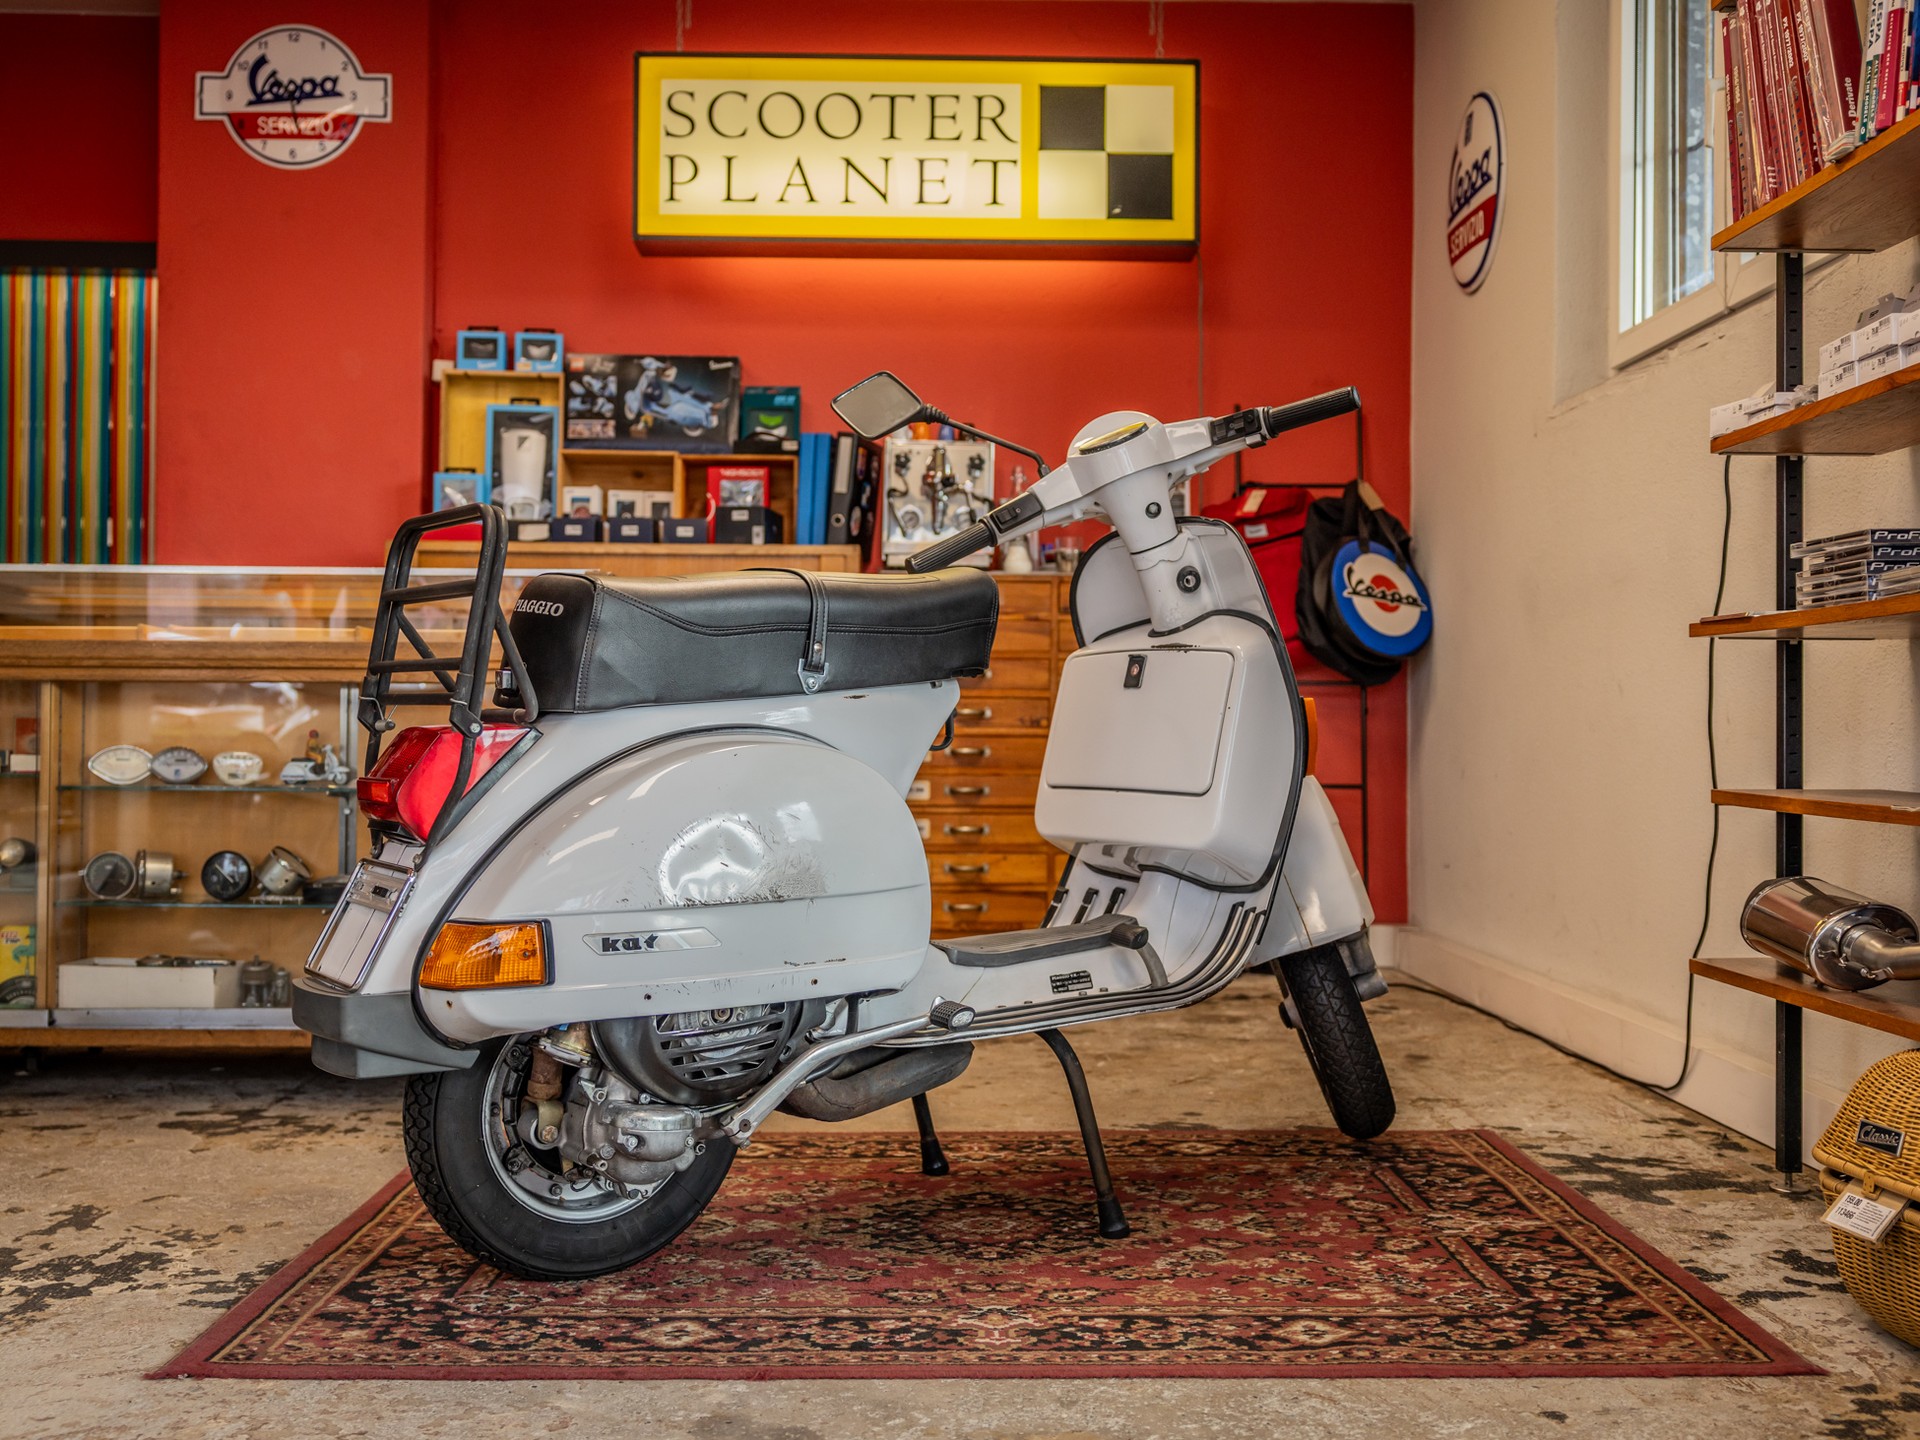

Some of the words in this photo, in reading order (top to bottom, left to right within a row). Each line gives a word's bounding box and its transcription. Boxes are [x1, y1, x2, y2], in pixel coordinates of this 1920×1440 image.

[288, 33, 301, 42] 12
[1782, 16, 1789, 29] PX
[1875, 1, 1884, 43] ESPA
[258, 40, 269, 50] 11
[1784, 29, 1795, 69] 1977/2002
[237, 60, 250, 71] 10
[246, 53, 345, 107] Vespa
[341, 61, 350, 71] 2
[1844, 77, 1857, 117] Derivate
[257, 116, 334, 136] SERVIZIO
[664, 90, 1019, 143] SCOOTER
[664, 154, 1019, 206] PLANET
[1448, 147, 1493, 226] Vespa
[1450, 210, 1485, 257] SERVIZIO
[1874, 530, 1920, 541] ProF
[1345, 564, 1425, 609] Vespa
[514, 599, 564, 617] PIAGGIO
[1858, 1125, 1899, 1147] Classic
